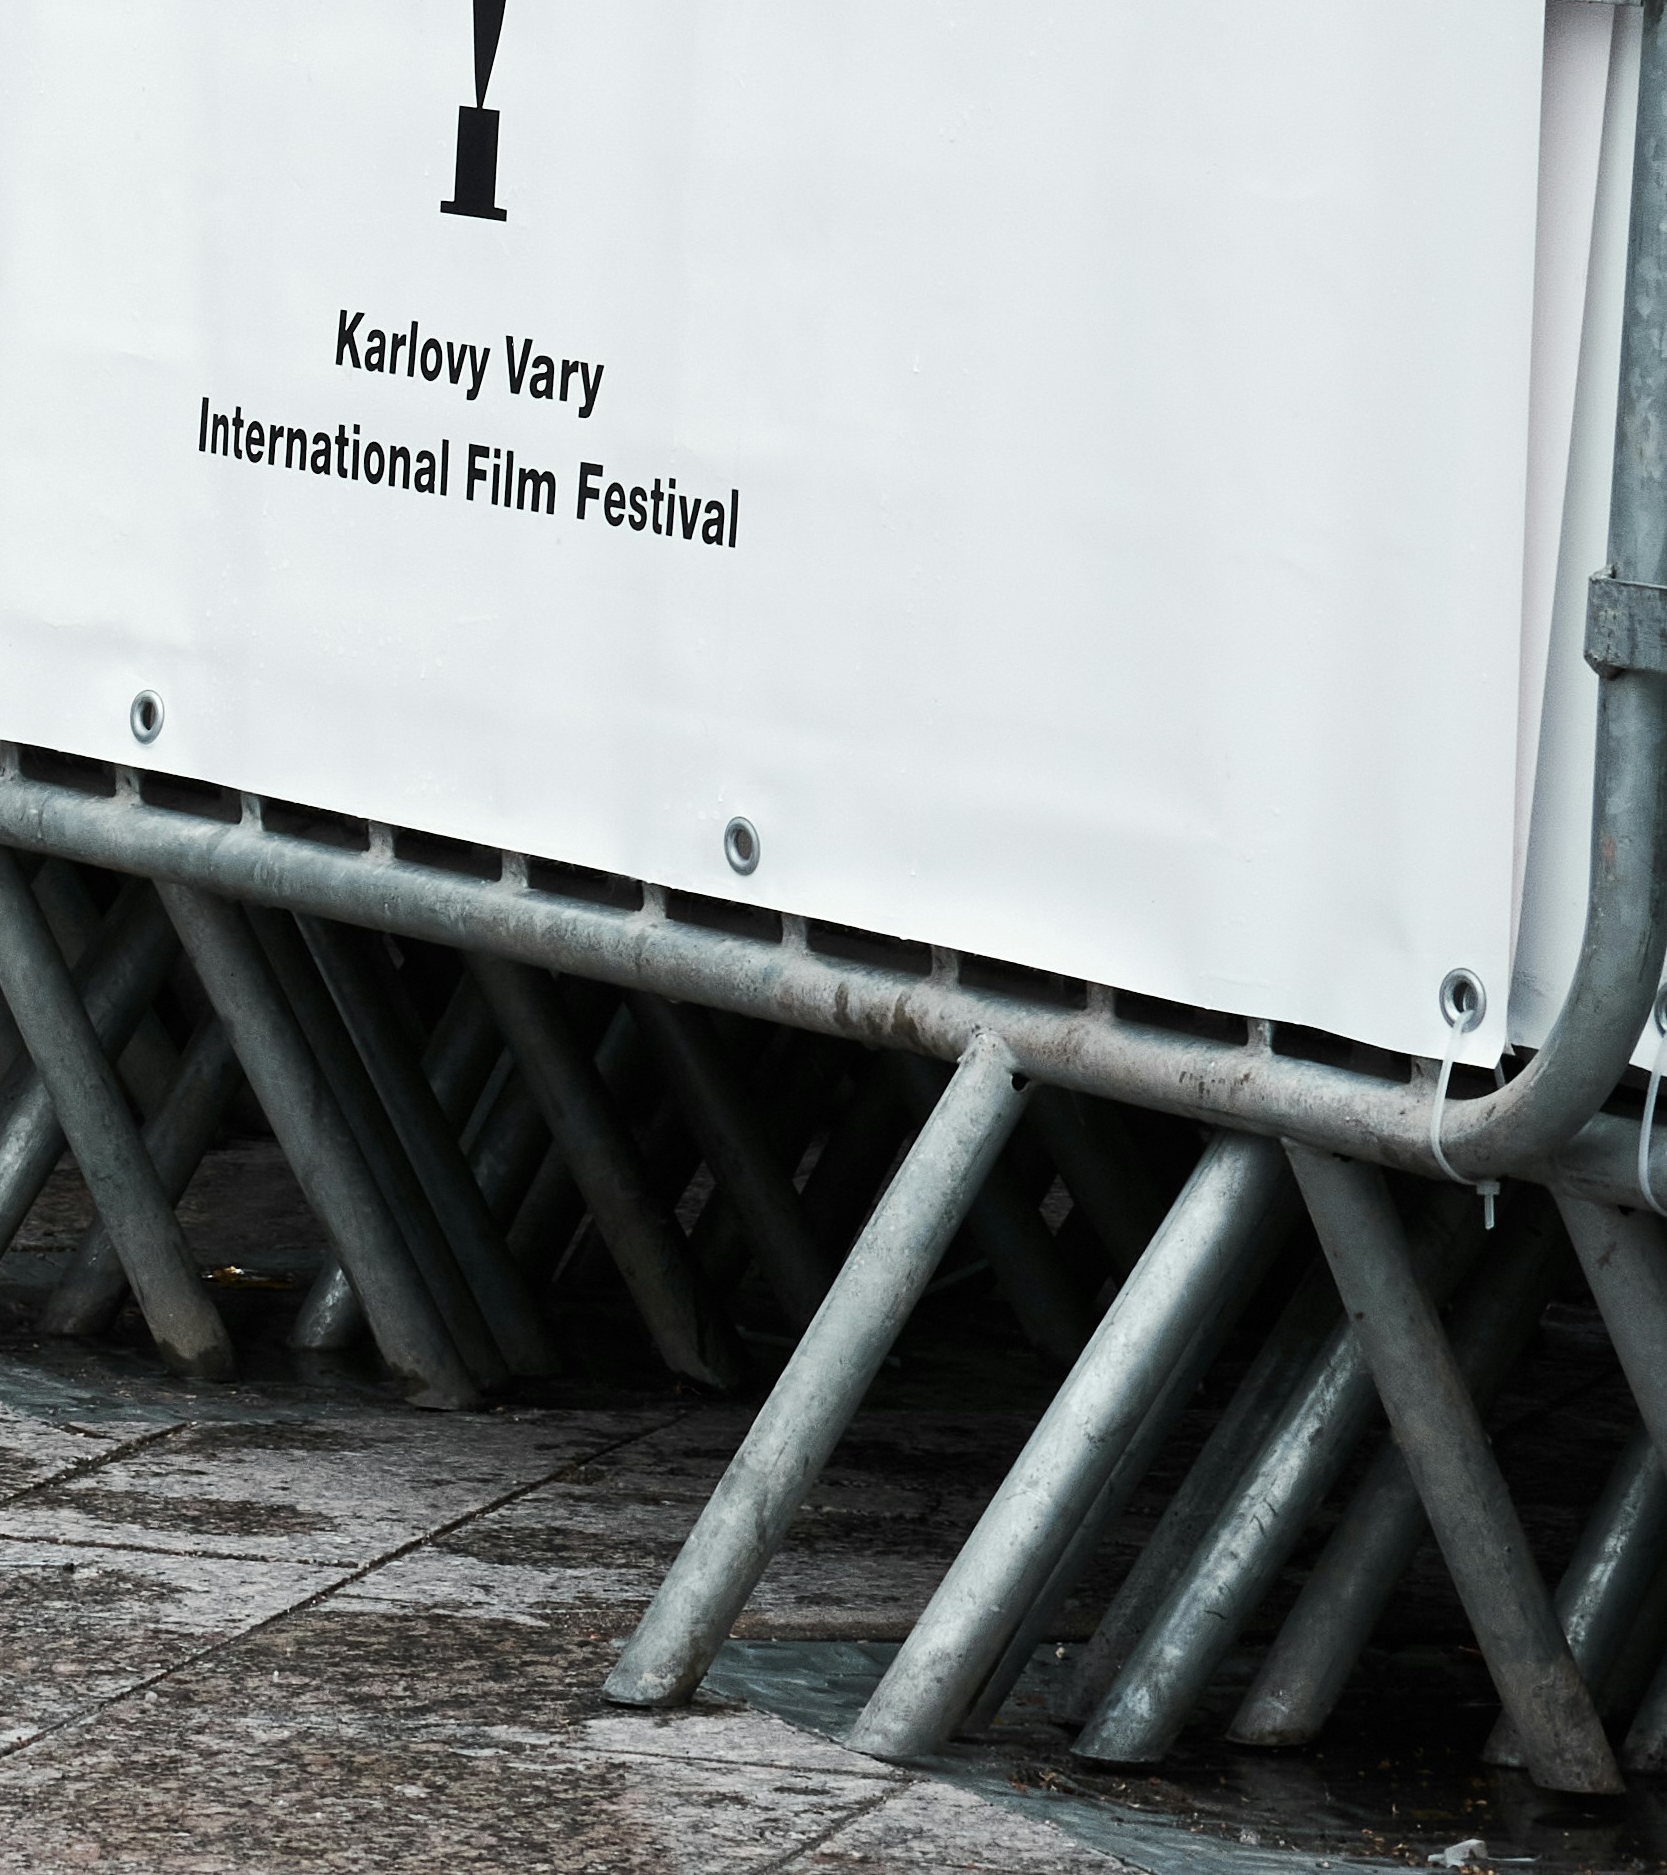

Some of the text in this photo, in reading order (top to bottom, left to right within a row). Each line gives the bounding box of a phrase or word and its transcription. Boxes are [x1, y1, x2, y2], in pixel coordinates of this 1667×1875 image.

[335, 309, 605, 419] Karlovy Vary
[198, 396, 739, 549] International Film Festival
